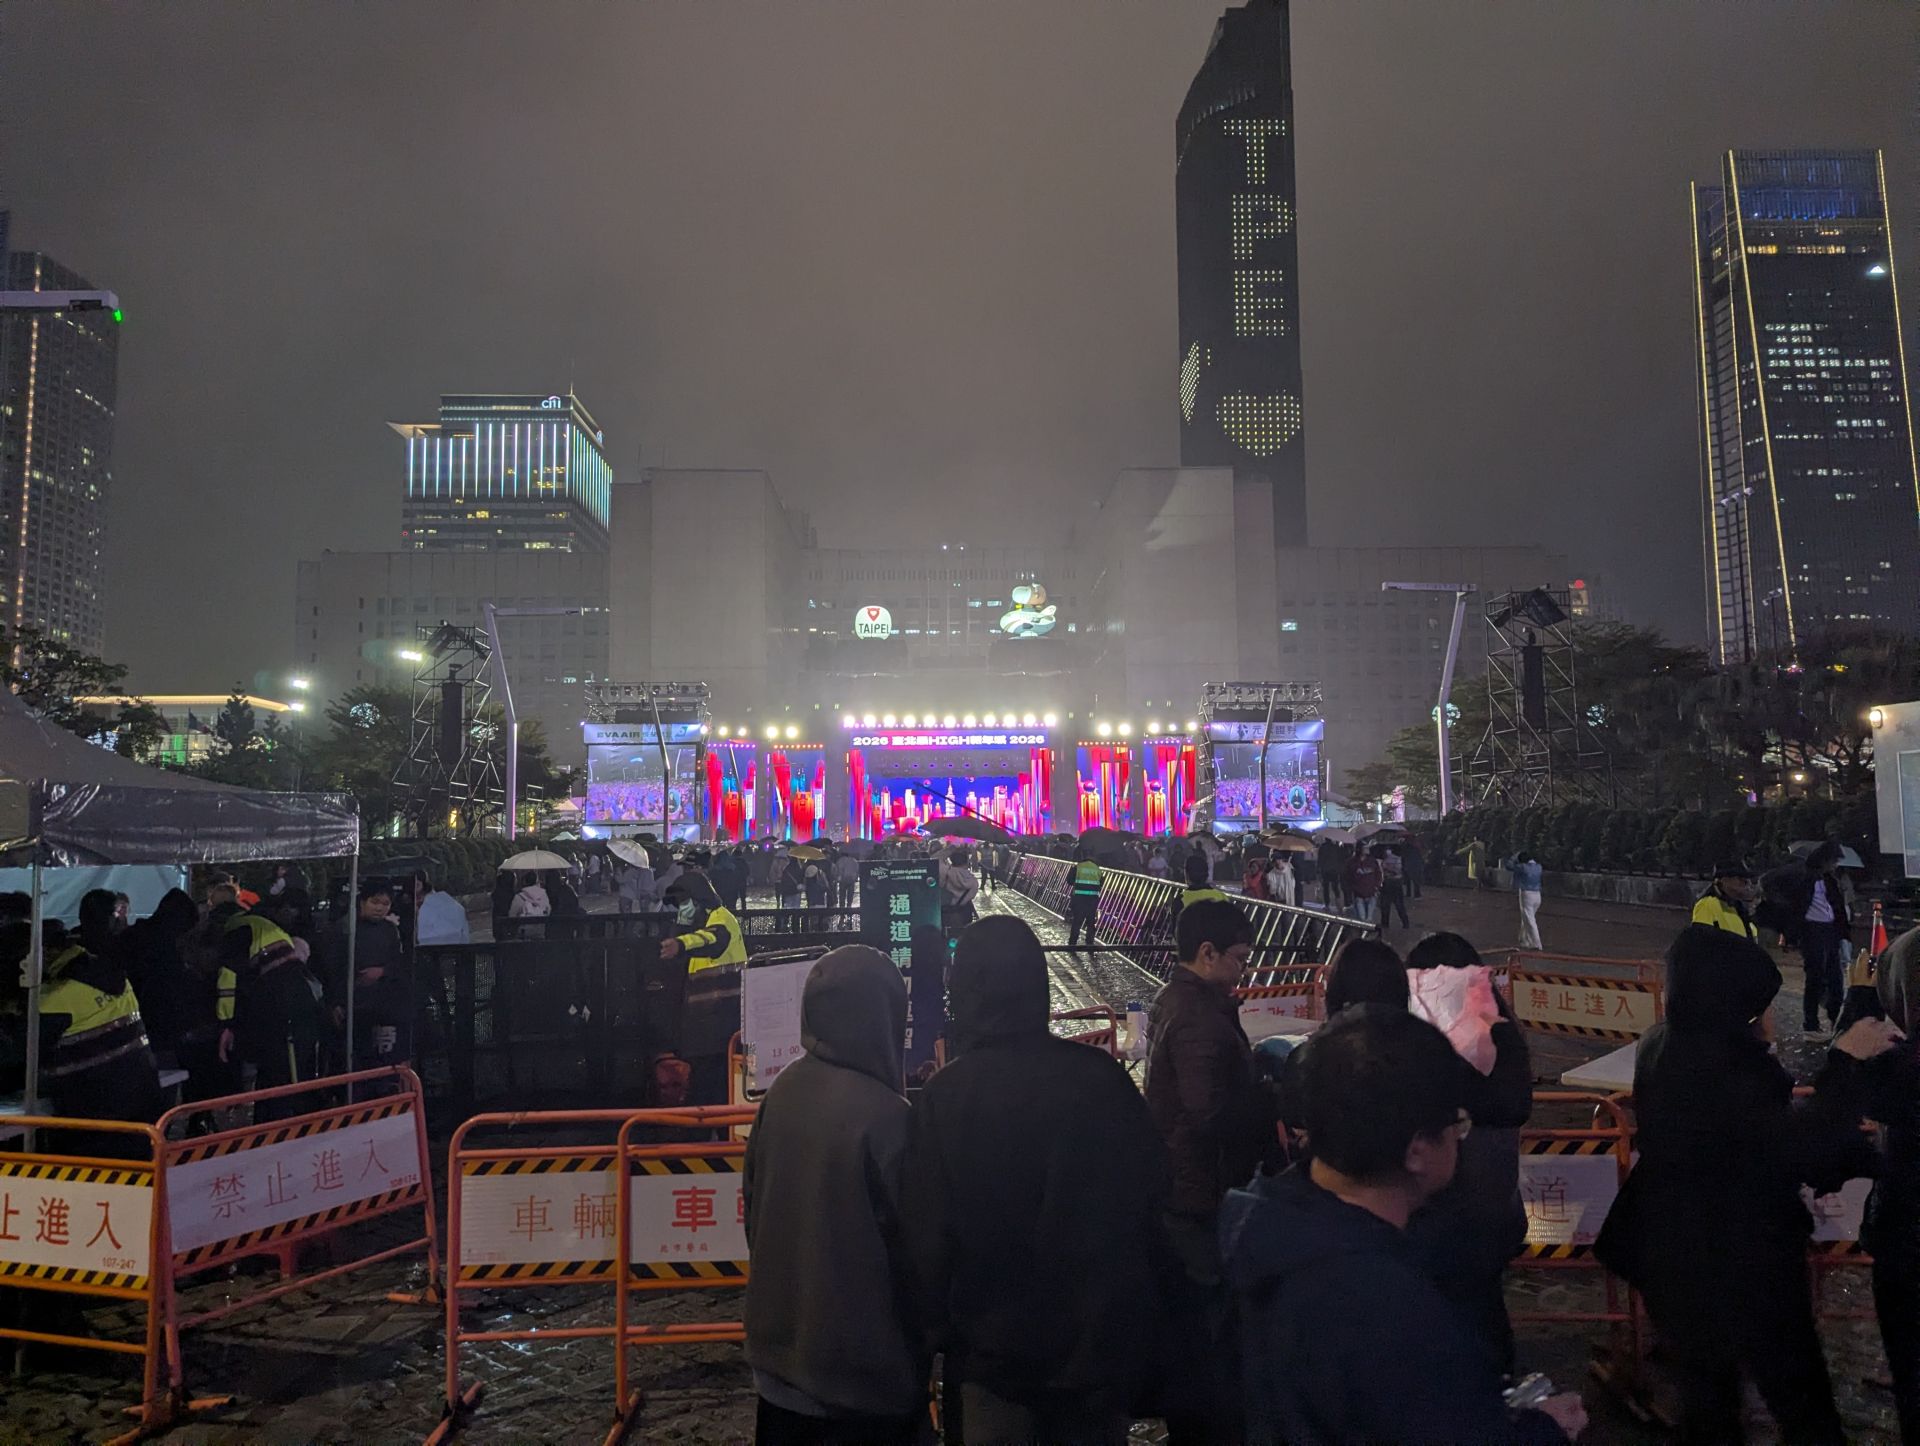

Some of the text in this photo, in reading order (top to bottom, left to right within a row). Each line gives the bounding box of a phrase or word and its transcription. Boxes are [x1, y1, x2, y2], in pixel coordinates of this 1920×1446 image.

[858, 623, 890, 634] TAIPEI
[853, 736, 889, 745] 2026
[1010, 735, 1045, 745] 2026
[1529, 986, 1634, 1019] 禁止進入
[208, 1137, 390, 1221] 禁止進入
[671, 1185, 745, 1233] 車
[101, 1256, 137, 1270] 107-247
